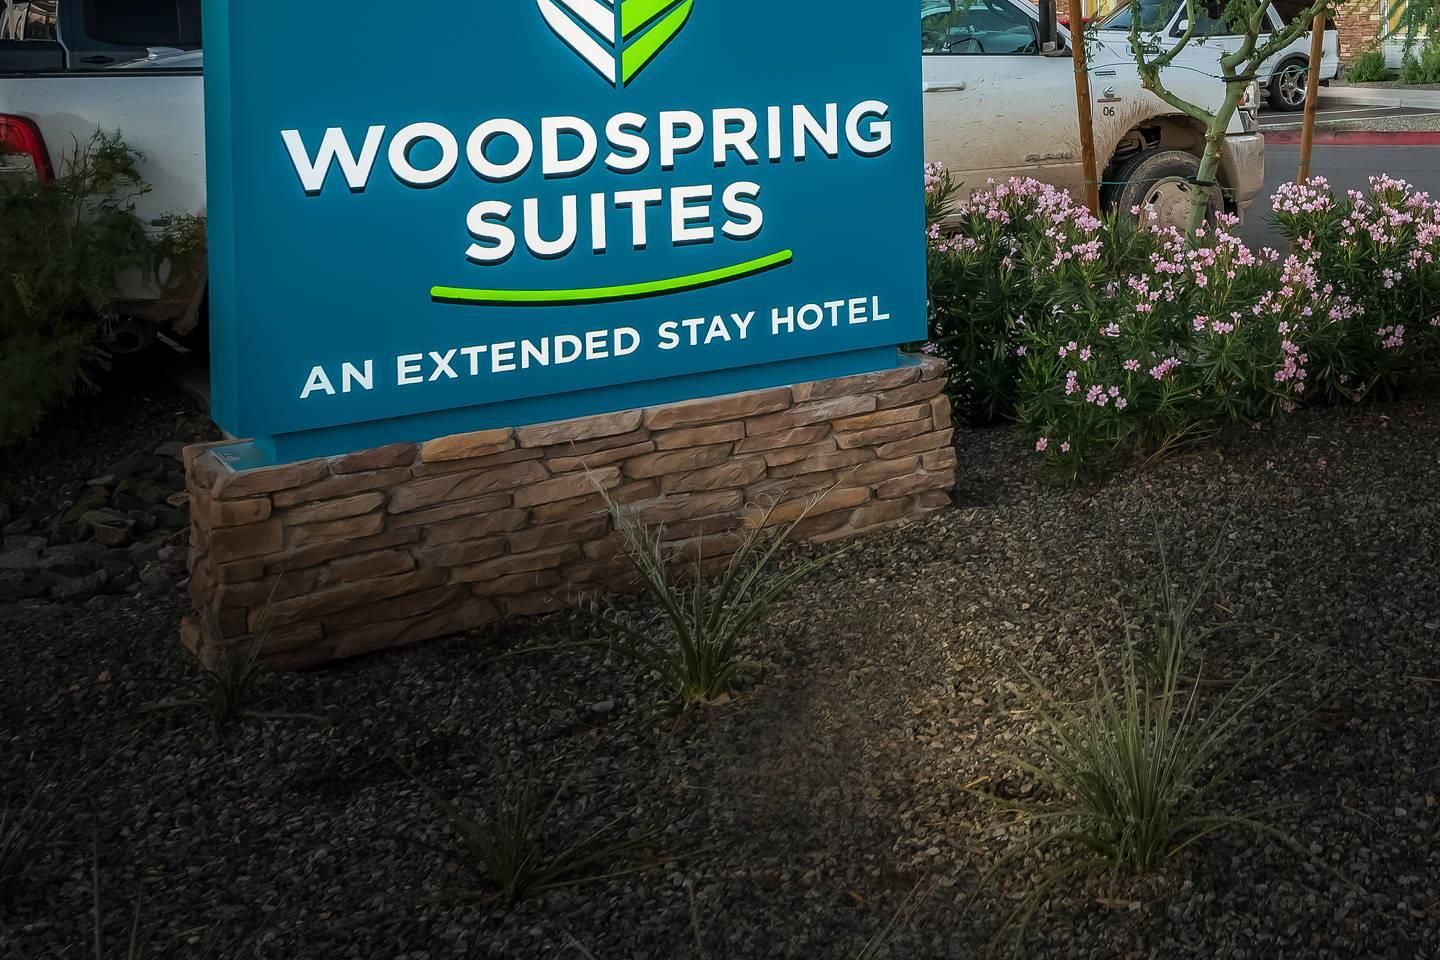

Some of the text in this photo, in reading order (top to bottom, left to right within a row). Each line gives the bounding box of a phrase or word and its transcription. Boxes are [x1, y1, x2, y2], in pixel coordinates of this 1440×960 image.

[281, 99, 893, 196] WOODSPRING
[1103, 106, 1115, 117] 06
[464, 181, 764, 266] SUITES
[299, 295, 890, 399] AN EXTENDED STAY HOTEL
